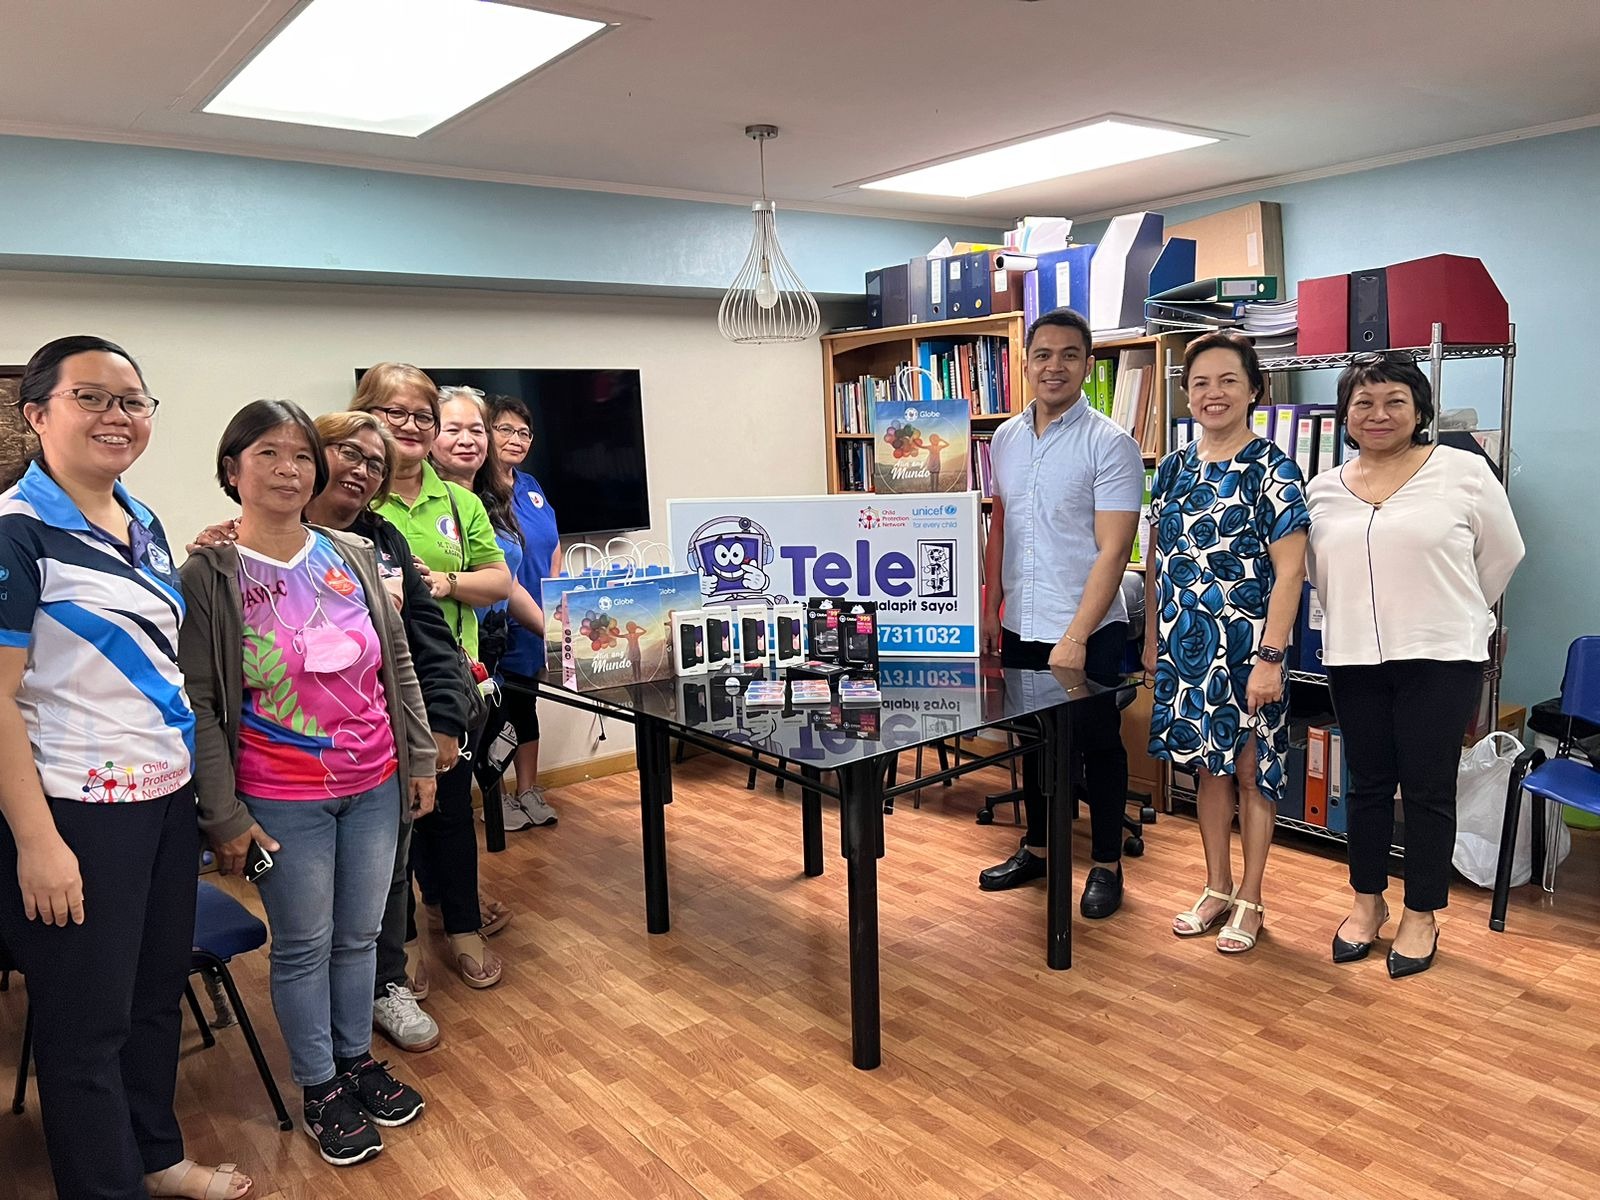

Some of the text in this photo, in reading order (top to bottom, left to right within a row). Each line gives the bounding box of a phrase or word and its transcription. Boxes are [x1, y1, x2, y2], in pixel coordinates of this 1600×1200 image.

[920, 410, 940, 418] Globe
[891, 467, 930, 479] Mundo
[912, 505, 944, 516] unicef
[780, 539, 916, 597] Tele
[613, 598, 634, 606] Globe
[876, 599, 958, 614] alapit Sayo!
[611, 651, 624, 659] ang
[591, 658, 632, 673] Mundo
[142, 760, 168, 774] Child
[142, 767, 187, 787] Protection
[142, 780, 181, 799] Network
